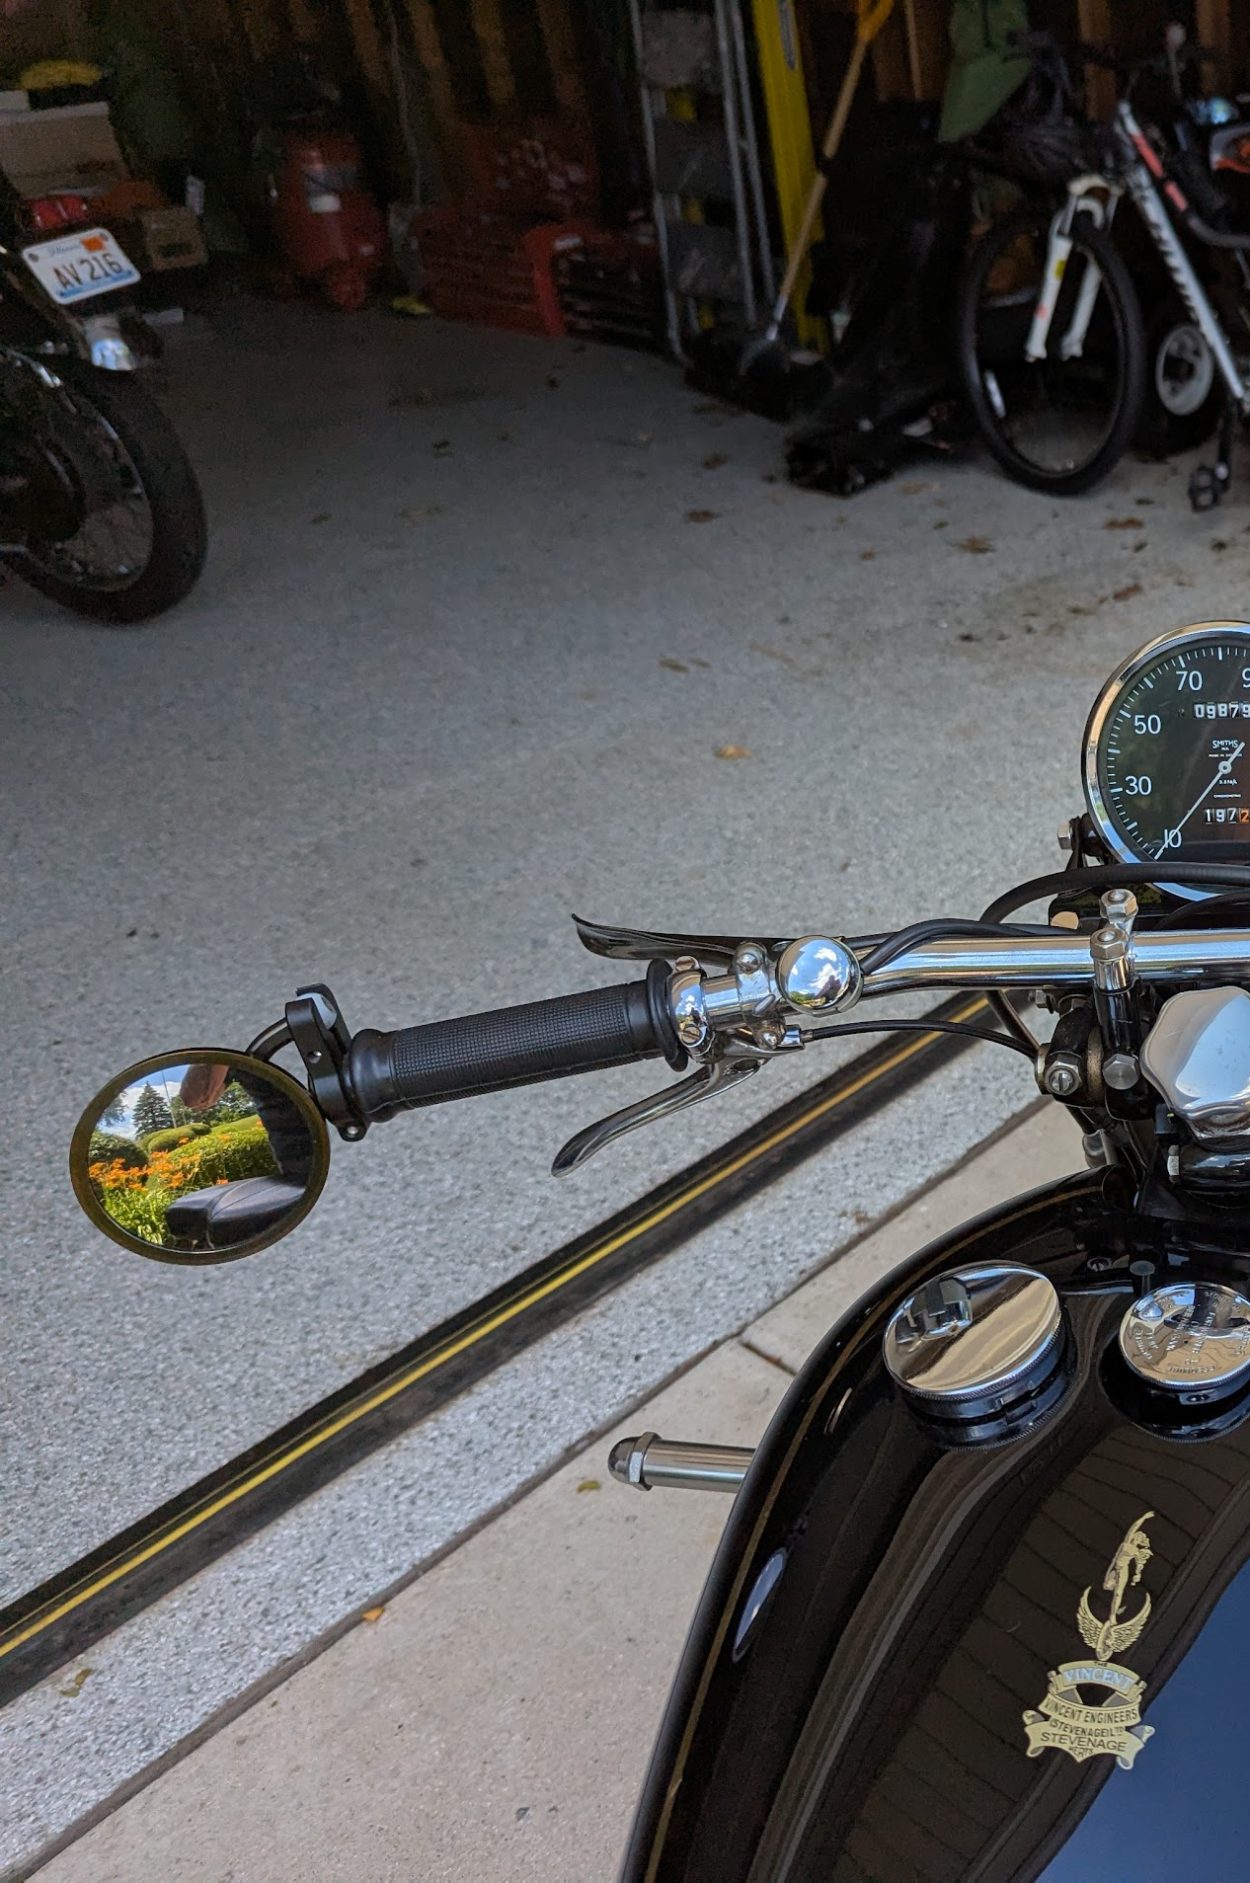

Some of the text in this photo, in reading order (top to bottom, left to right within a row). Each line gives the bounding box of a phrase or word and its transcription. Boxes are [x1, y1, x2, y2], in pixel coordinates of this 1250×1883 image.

[1175, 671, 1203, 691] 70
[1133, 715, 1162, 735] 50
[1212, 739, 1239, 749] SMITHS
[1124, 776, 1152, 796] 30
[1205, 807, 1250, 823] 1972
[1163, 828, 1182, 848] 10
[1065, 1668, 1133, 1690] VINCENT
[1045, 1697, 1137, 1723] VINCENT ENGINEERS
[1040, 1731, 1127, 1752] STEVENAGE
